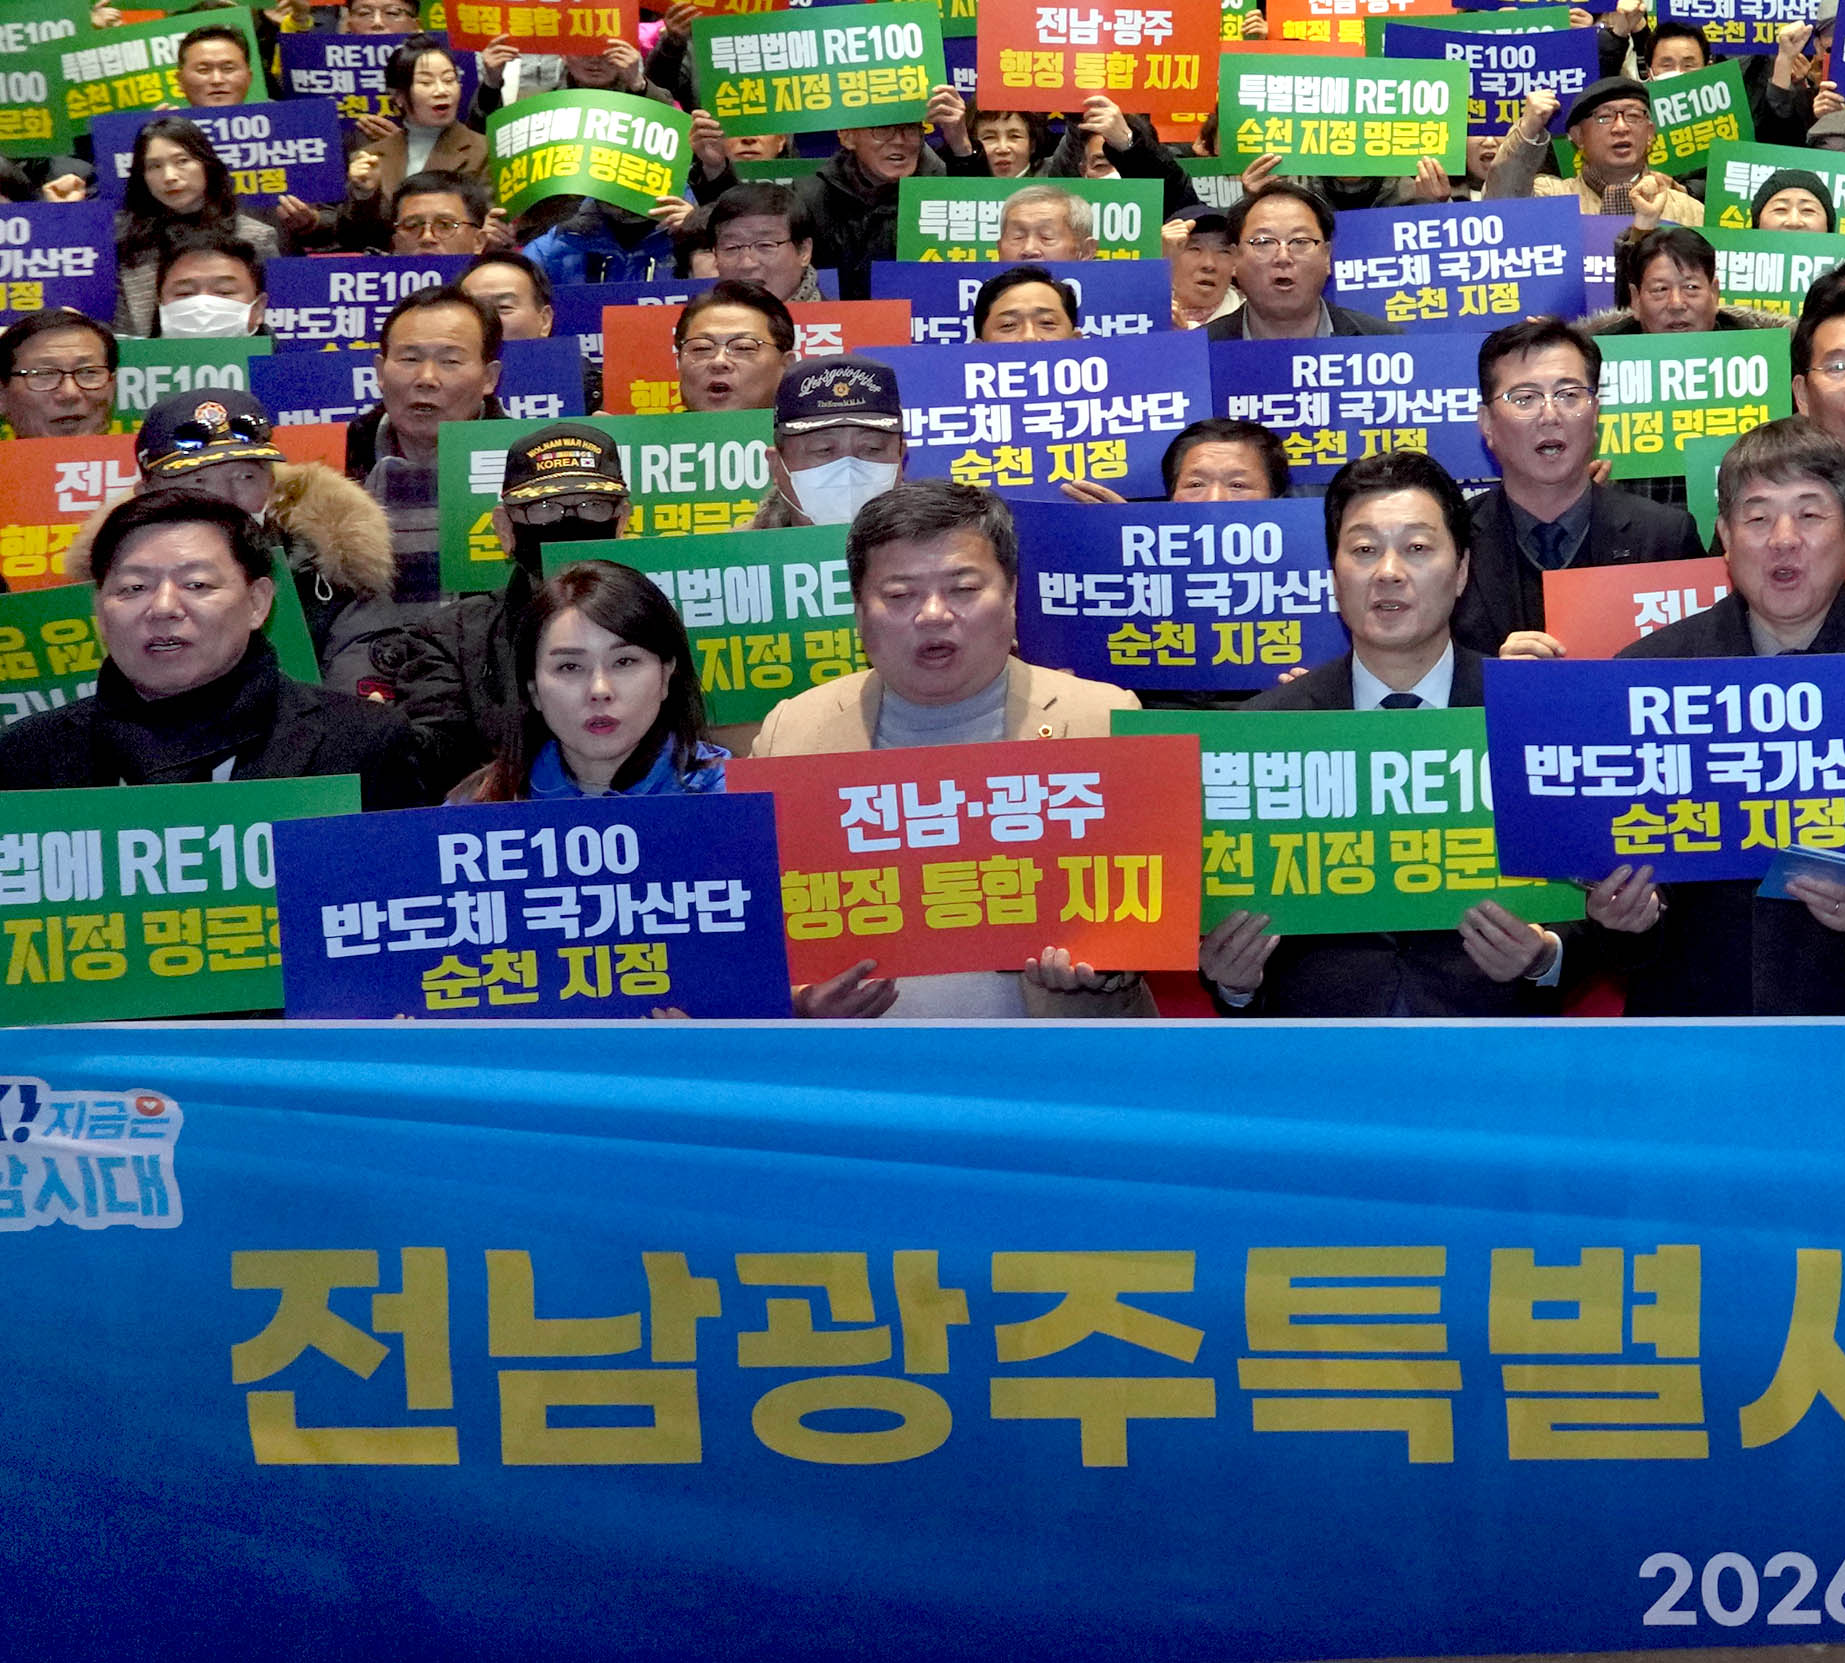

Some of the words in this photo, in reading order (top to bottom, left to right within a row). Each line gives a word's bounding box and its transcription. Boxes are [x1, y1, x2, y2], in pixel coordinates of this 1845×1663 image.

[1036, 8, 1172, 45] 전남·광주
[1000, 49, 1064, 87] 행정
[1074, 52, 1138, 89] 통합
[1144, 54, 1199, 89] 지지
[1239, 75, 1349, 113] 특별법에
[1356, 79, 1449, 115] RE100
[496, 107, 581, 158] 특별법에
[584, 108, 679, 161] RE100
[1238, 117, 1292, 156] 순천
[1300, 120, 1356, 155] 지정
[1364, 121, 1448, 156] 명문화
[531, 144, 584, 183] 지정
[589, 146, 672, 197] 명문화
[965, 357, 1108, 397] RE100
[1025, 395, 1189, 439] 국가산단
[536, 458, 579, 472] KOREA
[952, 446, 1033, 487] 순천
[1047, 440, 1127, 478] 지정
[1122, 522, 1282, 566] RE100
[1039, 572, 1172, 616] 반도체
[1108, 621, 1195, 665] 순천
[1213, 621, 1301, 664] 지정
[1629, 682, 1822, 735] RE100
[1525, 743, 1692, 796] 반도체
[839, 773, 1105, 852] 전남·광주
[1612, 800, 1720, 854] 순천
[438, 825, 639, 881] RE100
[1270, 831, 1375, 895] 지정
[322, 891, 506, 959] 반도체
[523, 880, 751, 939] 국가산단
[781, 867, 903, 940] 행정
[922, 855, 1043, 928] 통합
[1058, 855, 1162, 922] 지지
[4, 913, 127, 984] 지정
[143, 905, 282, 976] 명문
[422, 950, 538, 1009] 순천
[558, 944, 670, 998] 지정
